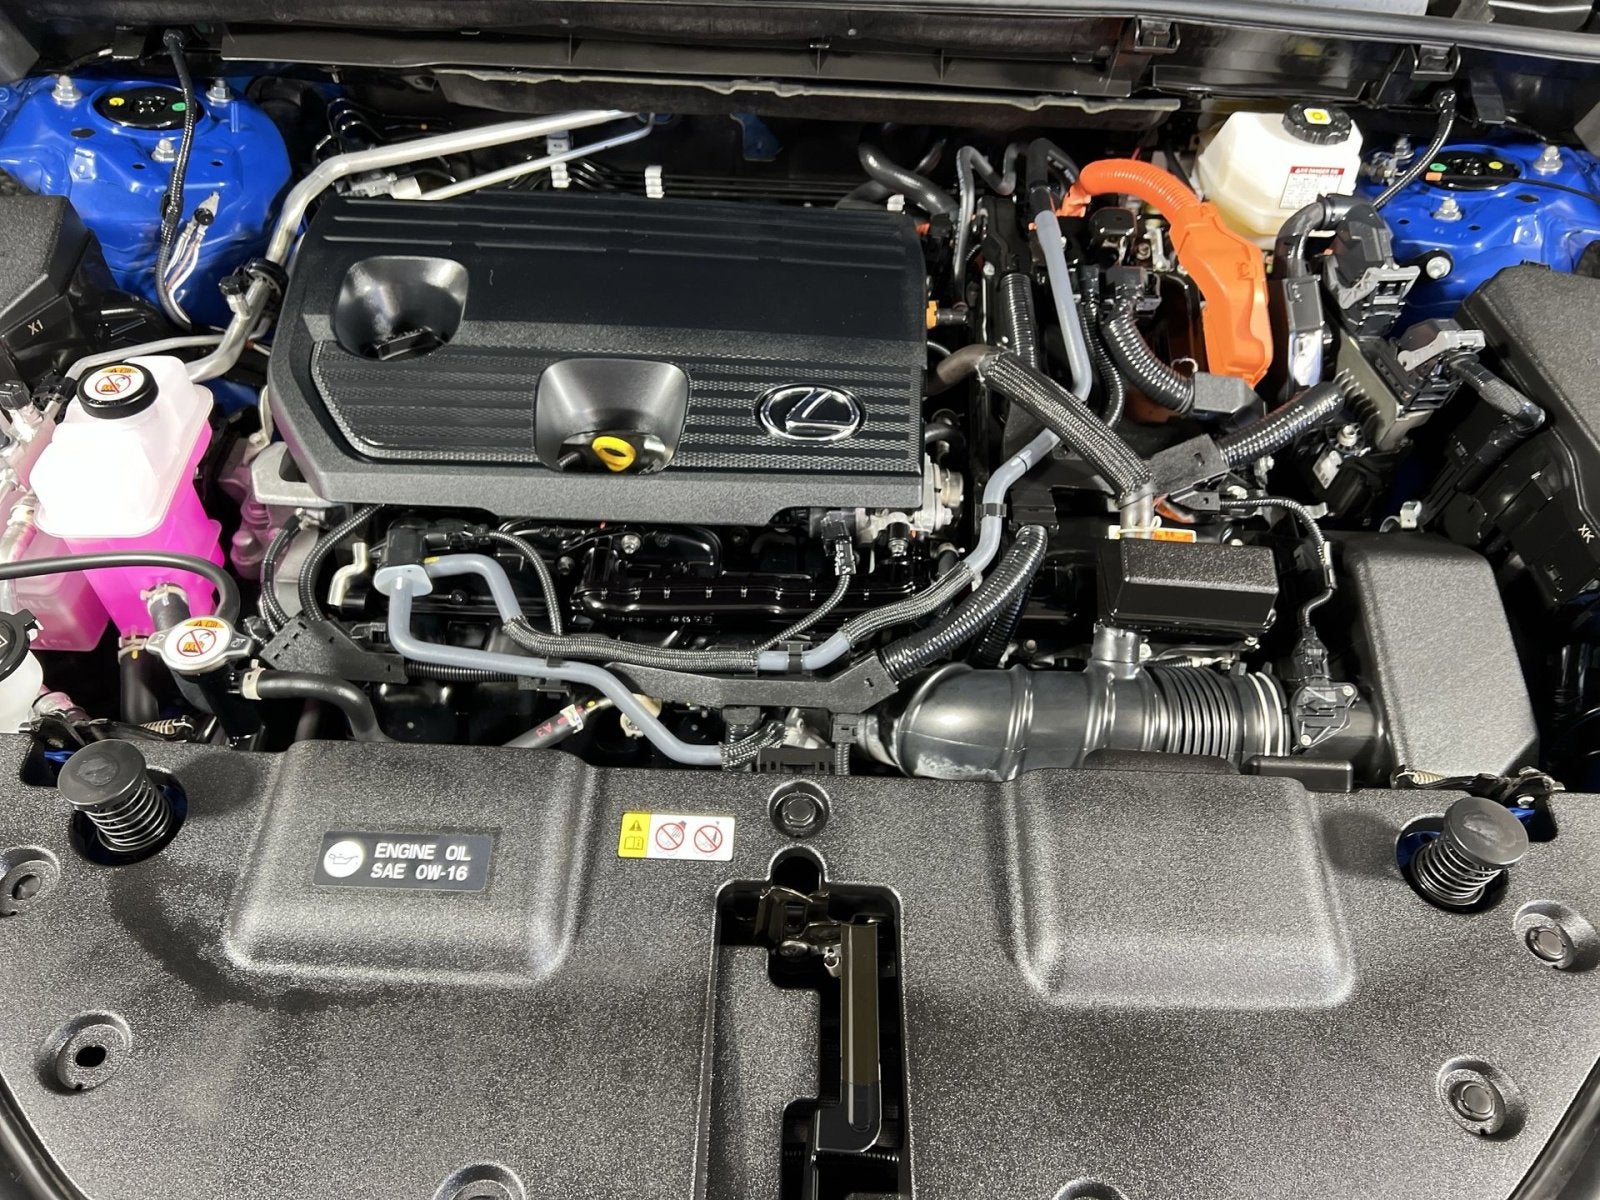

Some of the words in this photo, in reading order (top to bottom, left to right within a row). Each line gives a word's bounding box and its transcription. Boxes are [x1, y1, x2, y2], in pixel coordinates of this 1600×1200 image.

[27, 319, 44, 336] X1
[1577, 523, 1595, 544] XK
[374, 842, 437, 860] ENGINE
[445, 845, 472, 861] OIL
[370, 862, 407, 879] SAE
[415, 864, 469, 882] 0W-16
